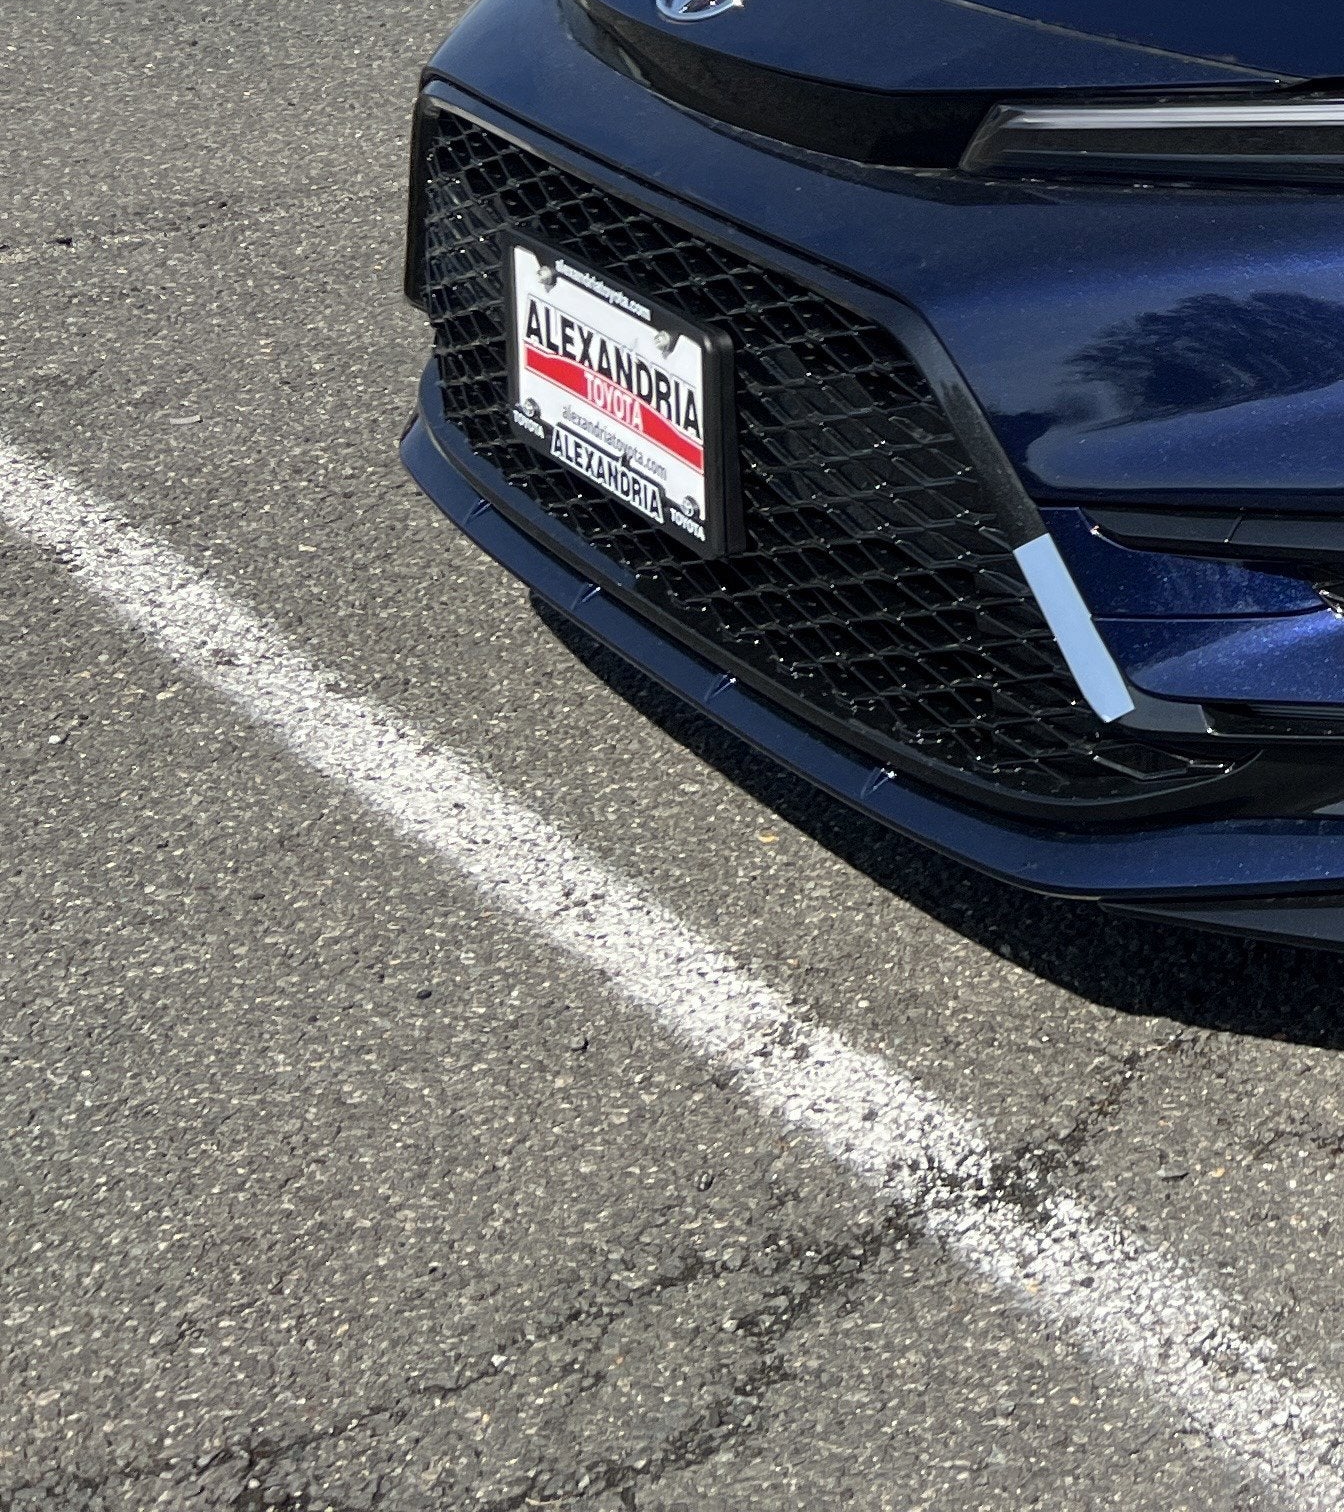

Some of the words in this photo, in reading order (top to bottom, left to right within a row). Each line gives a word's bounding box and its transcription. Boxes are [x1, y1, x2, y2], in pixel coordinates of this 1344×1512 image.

[525, 298, 702, 440] ALEXANDRIA
[583, 371, 645, 434] TOYOTA
[553, 429, 664, 522] ALEXANDRIA
[669, 507, 706, 542] TOYOTA
